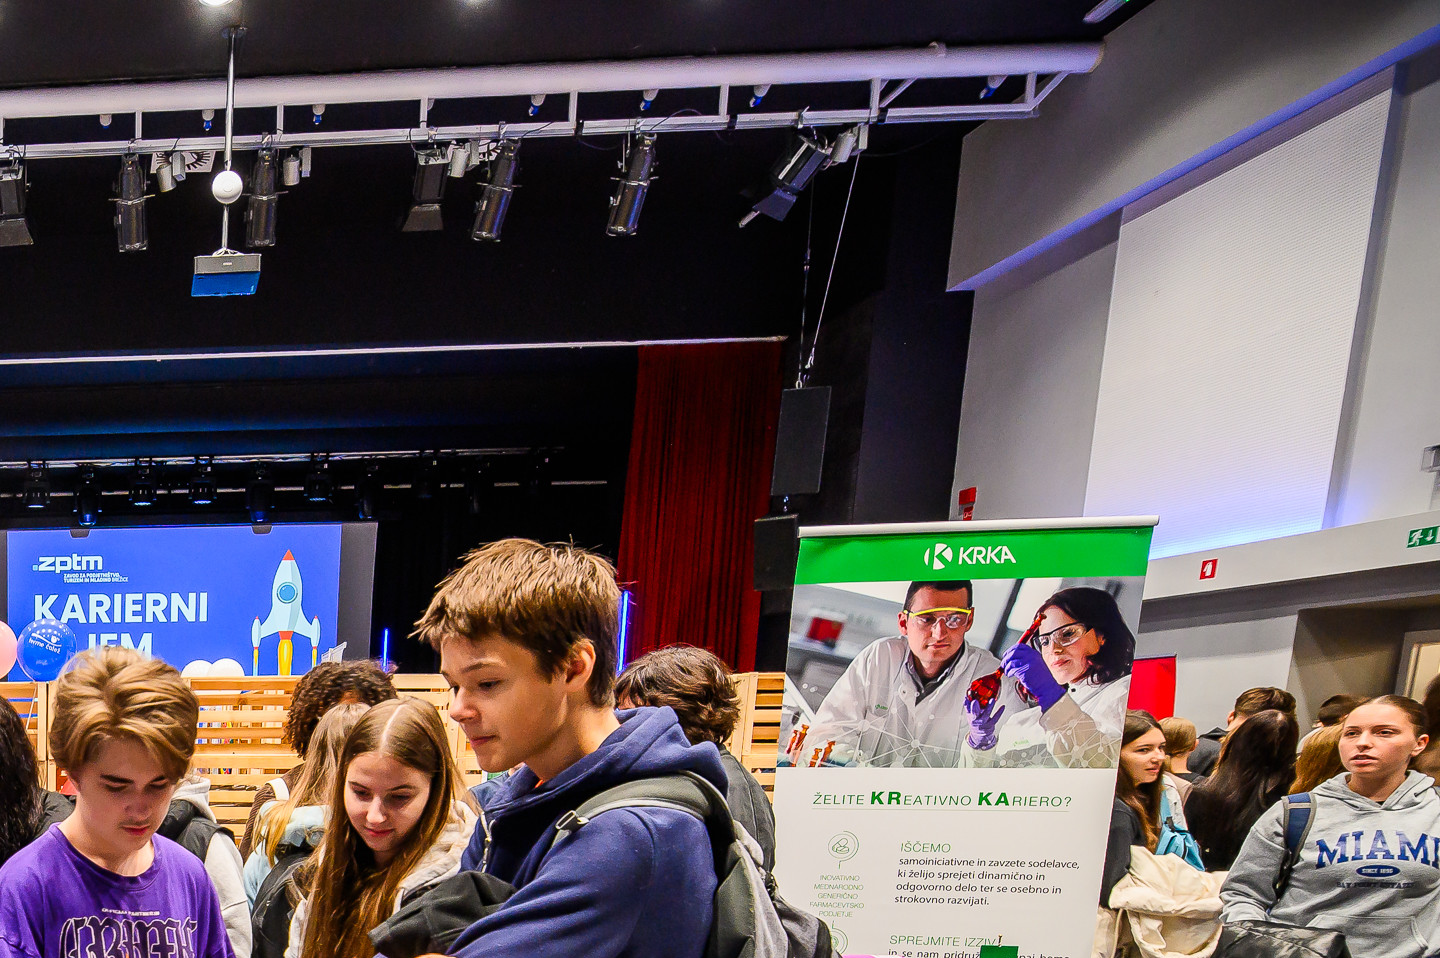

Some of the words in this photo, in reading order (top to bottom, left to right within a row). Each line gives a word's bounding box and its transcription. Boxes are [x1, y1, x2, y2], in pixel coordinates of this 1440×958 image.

[958, 545, 1016, 565] KRKA
[34, 591, 208, 625] KARIERNI
[812, 791, 865, 806] ŽELITE
[977, 791, 1072, 808] KARIERO?
[900, 840, 952, 854] IŠČEMO
[898, 857, 975, 867] samoiniciativne
[976, 857, 986, 867] in
[988, 859, 1026, 868] zavzete
[1027, 858, 1080, 870] sodelavce,
[819, 874, 861, 882] INOVATIVNO
[897, 868, 906, 878] ki
[908, 869, 935, 880] želijo
[937, 870, 976, 882] sprejeti
[977, 870, 1033, 881] dinamično
[1035, 871, 1046, 881] in
[813, 883, 864, 891] MEDNARODNO
[895, 882, 953, 893] odgovorno
[954, 883, 978, 893] delo
[980, 884, 994, 893] ter
[1010, 884, 1050, 894] osebno
[1051, 885, 1062, 895] in
[817, 891, 859, 900] GENERIČNO
[894, 895, 945, 905] strokovno
[947, 896, 990, 907] razvijati.
[818, 910, 853, 918] PODJETJE
[889, 934, 960, 947] SPREJMITE
[902, 950, 913, 958] se
[916, 950, 939, 958] nam
